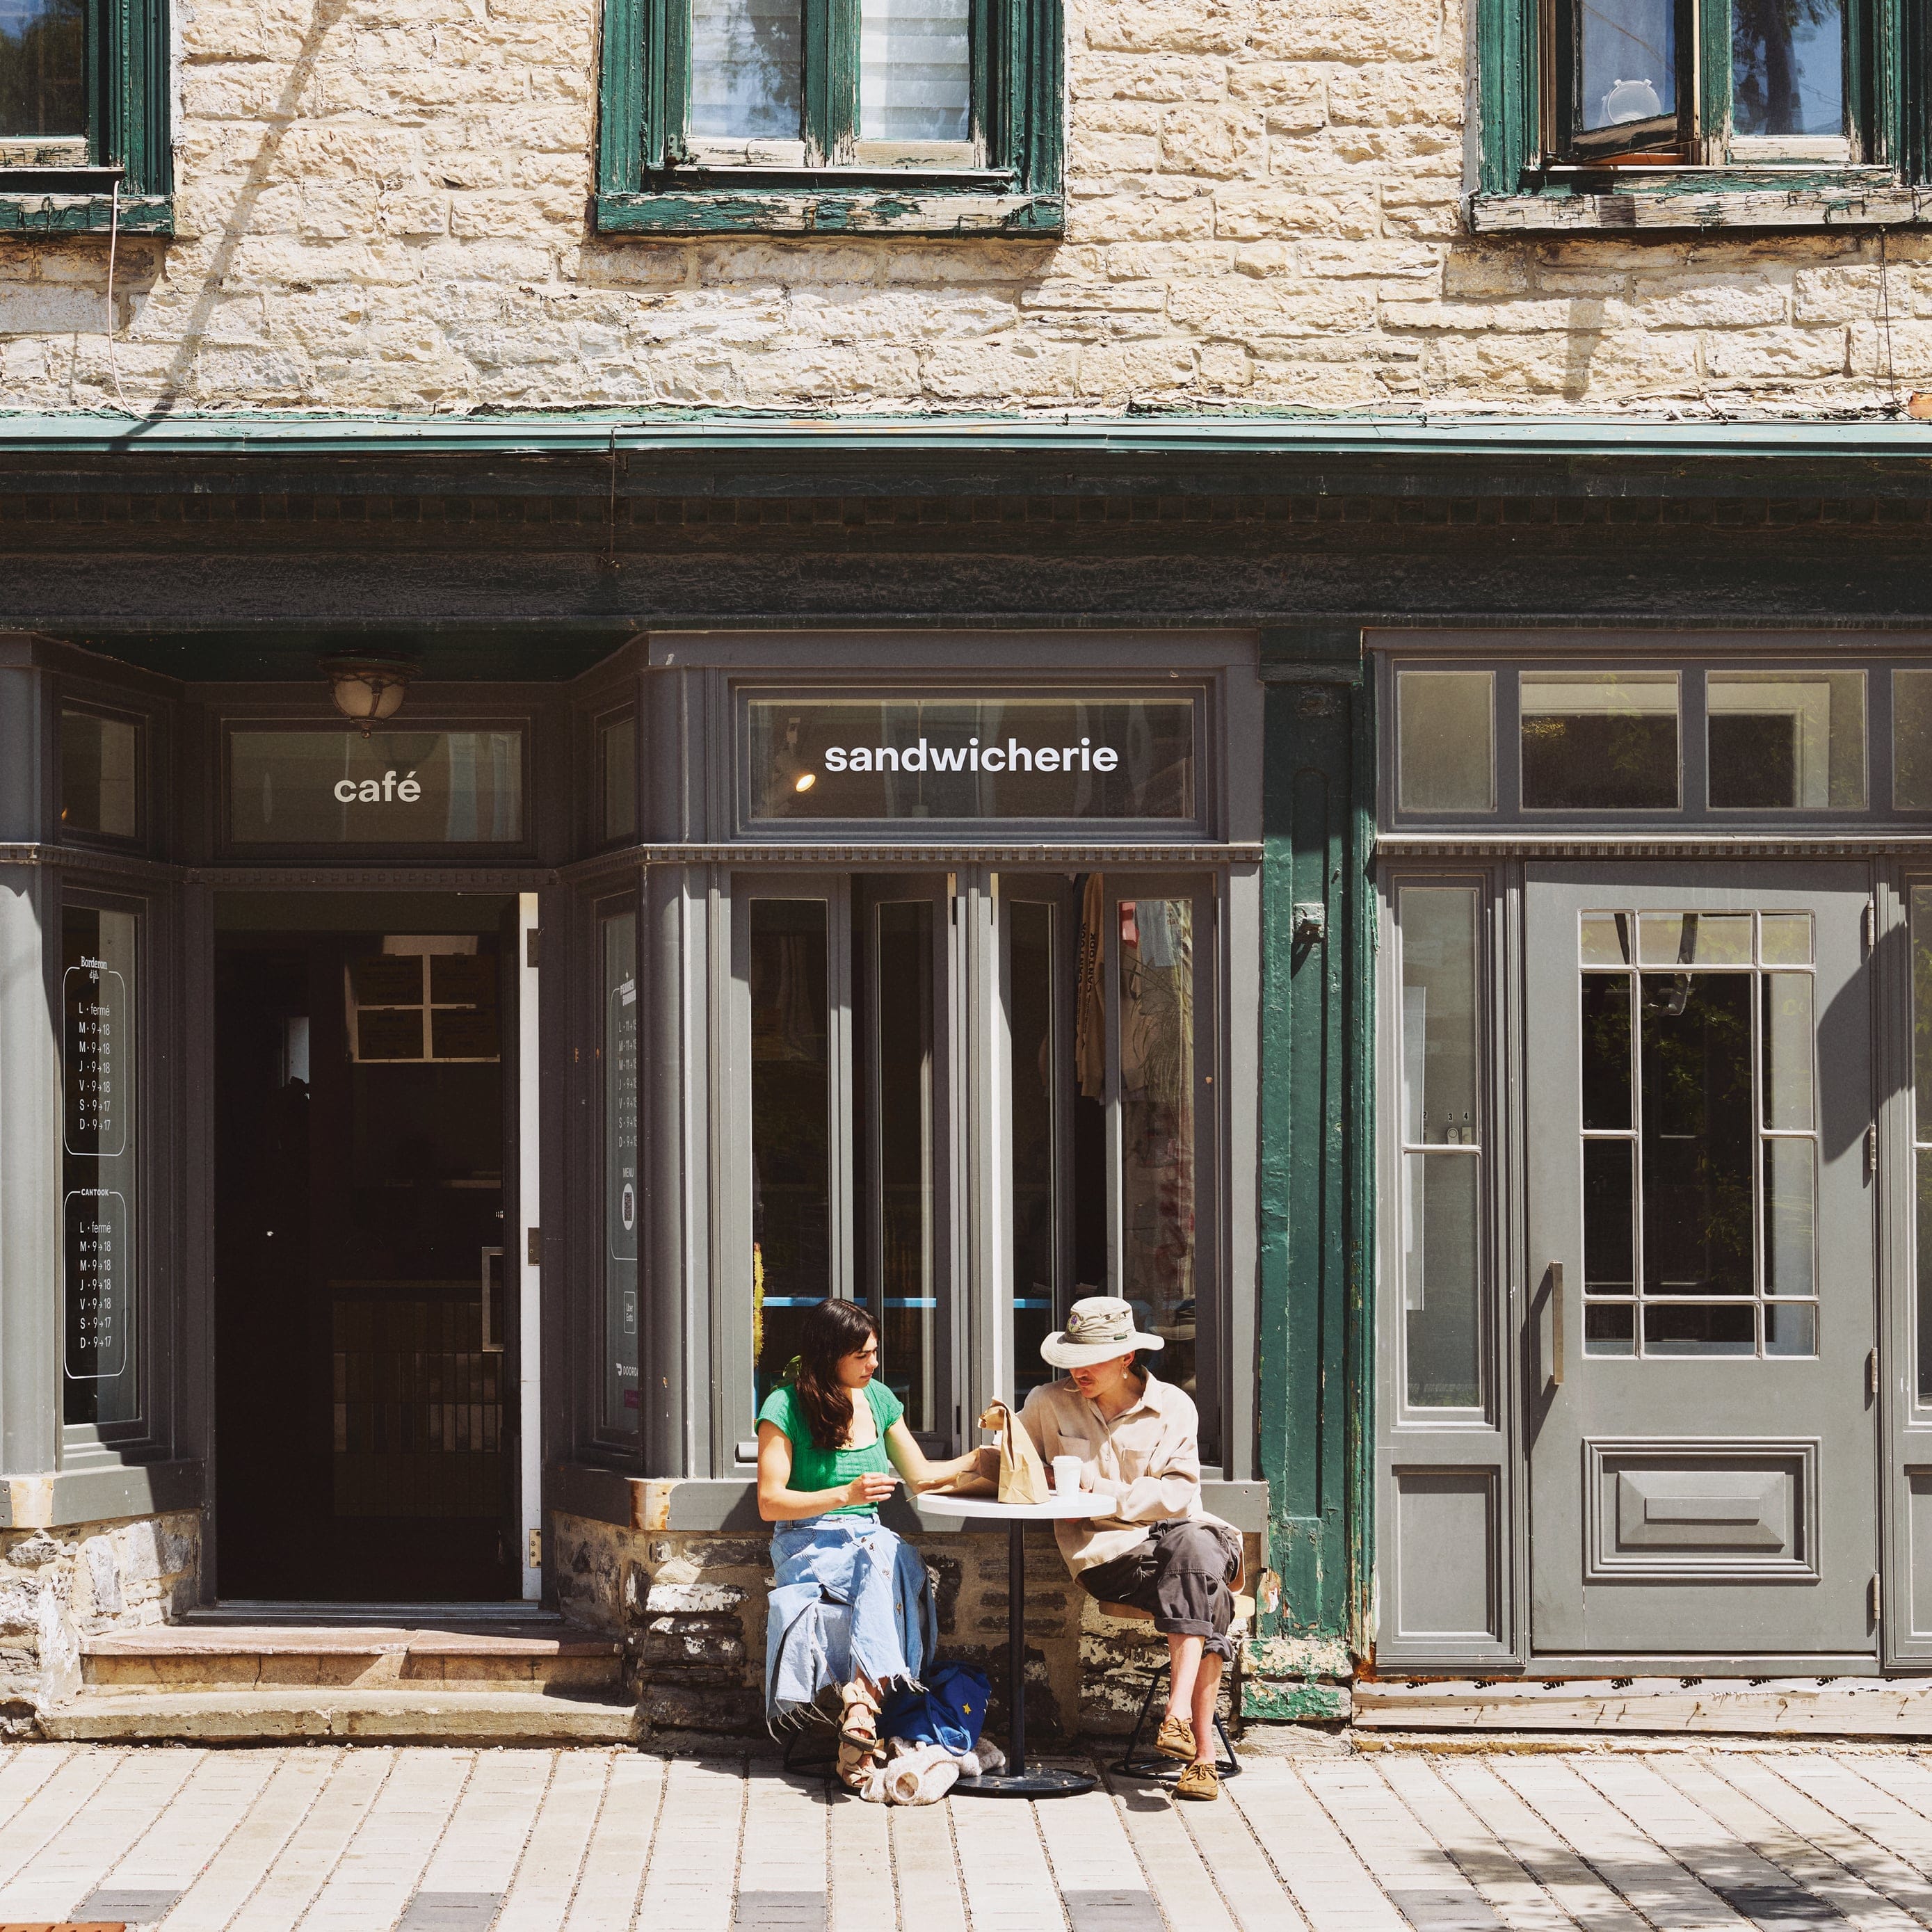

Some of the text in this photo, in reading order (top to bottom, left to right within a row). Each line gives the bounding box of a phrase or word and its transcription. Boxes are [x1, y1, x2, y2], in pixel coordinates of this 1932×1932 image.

[825, 738, 1118, 772] sandwicherie
[334, 771, 421, 803] café
[81, 956, 108, 969] Borderon
[1086, 932, 1096, 993] CANTOOK
[79, 1002, 110, 1016] L fermé
[79, 1022, 111, 1036] M 9 18
[79, 1040, 111, 1055] M 9 18
[618, 1040, 623, 1052] M
[79, 1060, 111, 1074] J 9 18
[619, 1058, 623, 1071] M
[79, 1079, 111, 1093] V 9 18
[618, 1079, 622, 1090] J
[626, 1077, 630, 1089] 9
[79, 1098, 111, 1112] S 9 17
[619, 1097, 622, 1109] V
[626, 1097, 630, 1109] 9
[79, 1118, 111, 1131] D 9 17
[619, 1117, 622, 1129] S
[626, 1116, 630, 1128] 9
[619, 1136, 623, 1148] D
[626, 1135, 630, 1147] 9
[622, 1167, 634, 1178] MENU
[81, 1188, 110, 1196] CANTOOK
[80, 1221, 111, 1234] L fermé
[80, 1241, 111, 1252] M 9 18
[80, 1259, 111, 1271] M 9 18
[80, 1278, 111, 1291] J 9 18
[80, 1298, 111, 1310] V 9 18
[80, 1317, 111, 1329] S 9 17
[80, 1336, 111, 1349] D 9 17
[623, 1365, 638, 1377] DOORD
[1611, 1678, 1634, 1690] 3M
[1680, 1677, 1702, 1689] 3M
